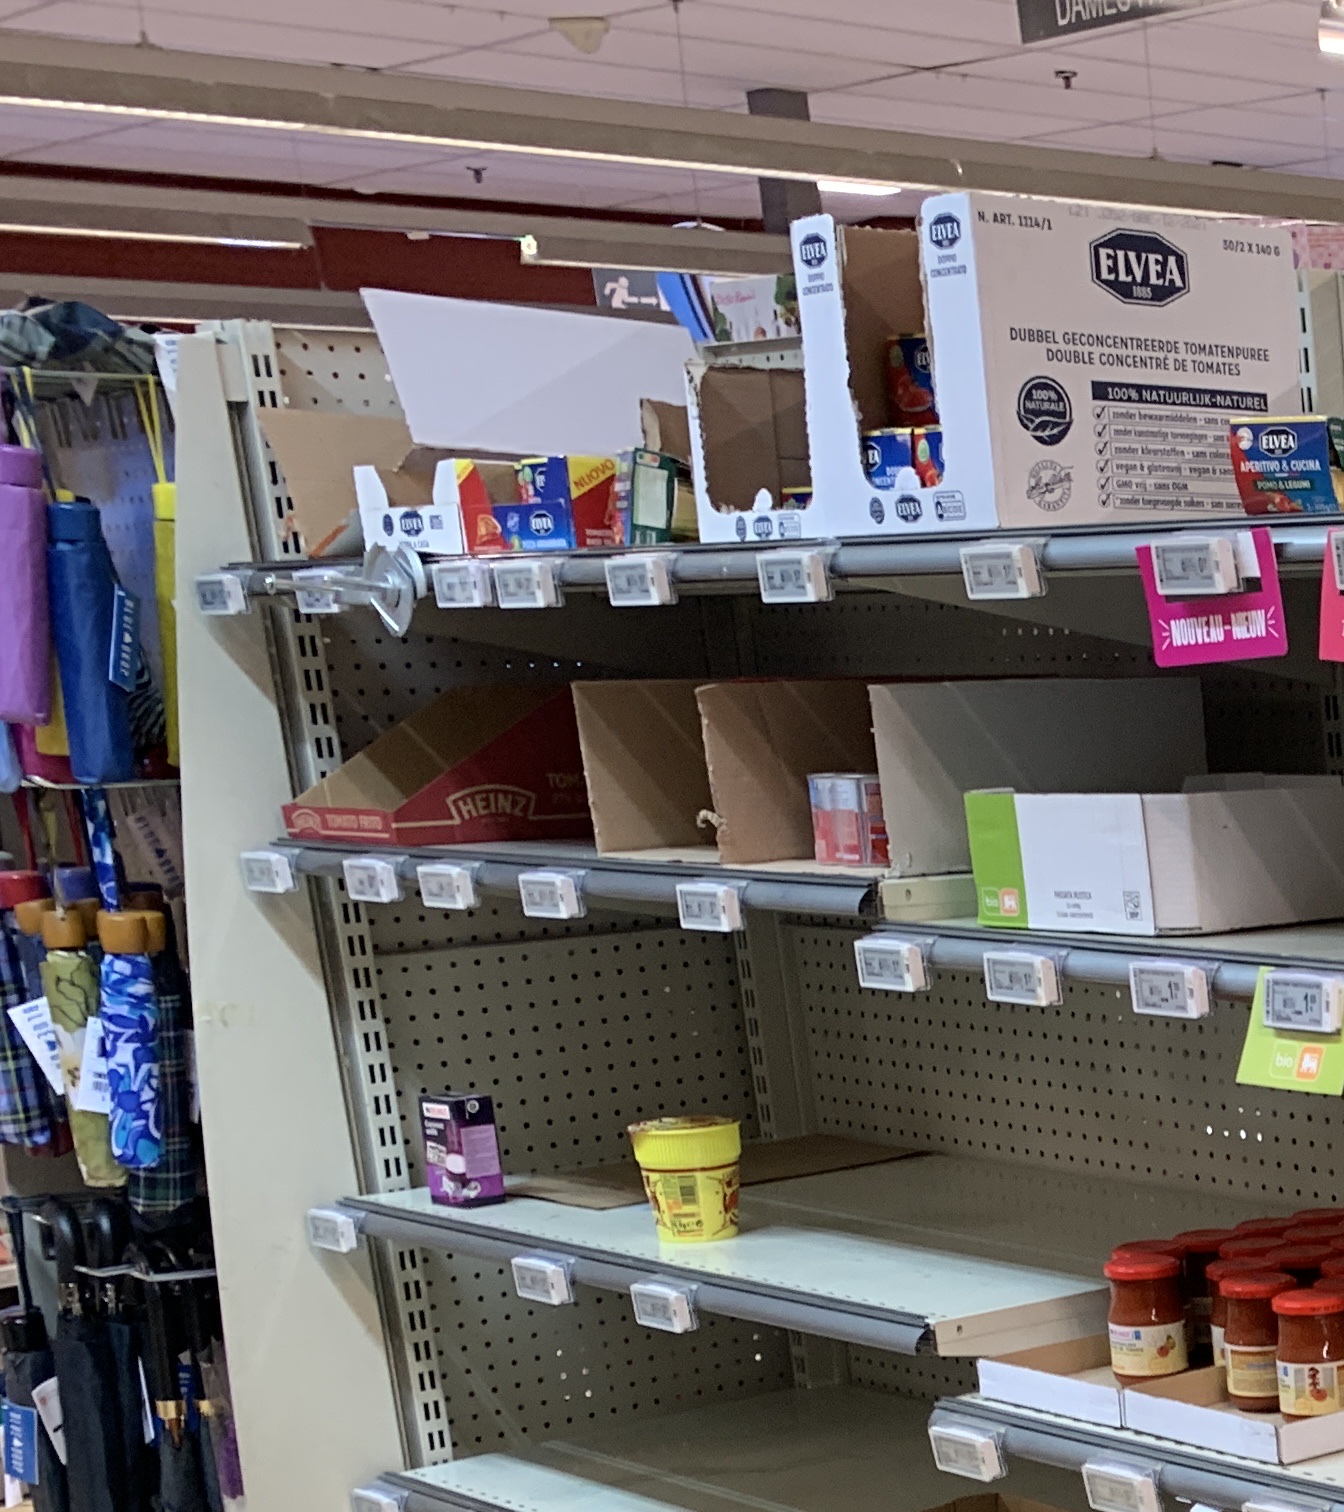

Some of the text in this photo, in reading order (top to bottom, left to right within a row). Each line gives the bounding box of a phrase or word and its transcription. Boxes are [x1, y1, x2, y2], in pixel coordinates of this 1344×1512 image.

[991, 213, 1015, 226] ART.
[930, 221, 961, 242] ELVEA
[801, 243, 828, 261] ELVEA
[1099, 247, 1184, 288] ELVEA
[1009, 327, 1270, 362] DUBBEL GECONCENTREERDE TOMATENPUREE
[1046, 348, 1241, 377] DOUBLE CONCENTRÉ DE TOMATES
[1107, 386, 1138, 401] 100%
[1025, 400, 1065, 412] NATURALE
[1261, 434, 1296, 450] ELVEA
[1290, 460, 1321, 472] CUCINA
[573, 459, 616, 492] NUOVO
[459, 795, 526, 820] HEINZ
[325, 814, 359, 830] TOMATO
[359, 815, 383, 831] FRITO
[1275, 1051, 1294, 1068] bio
